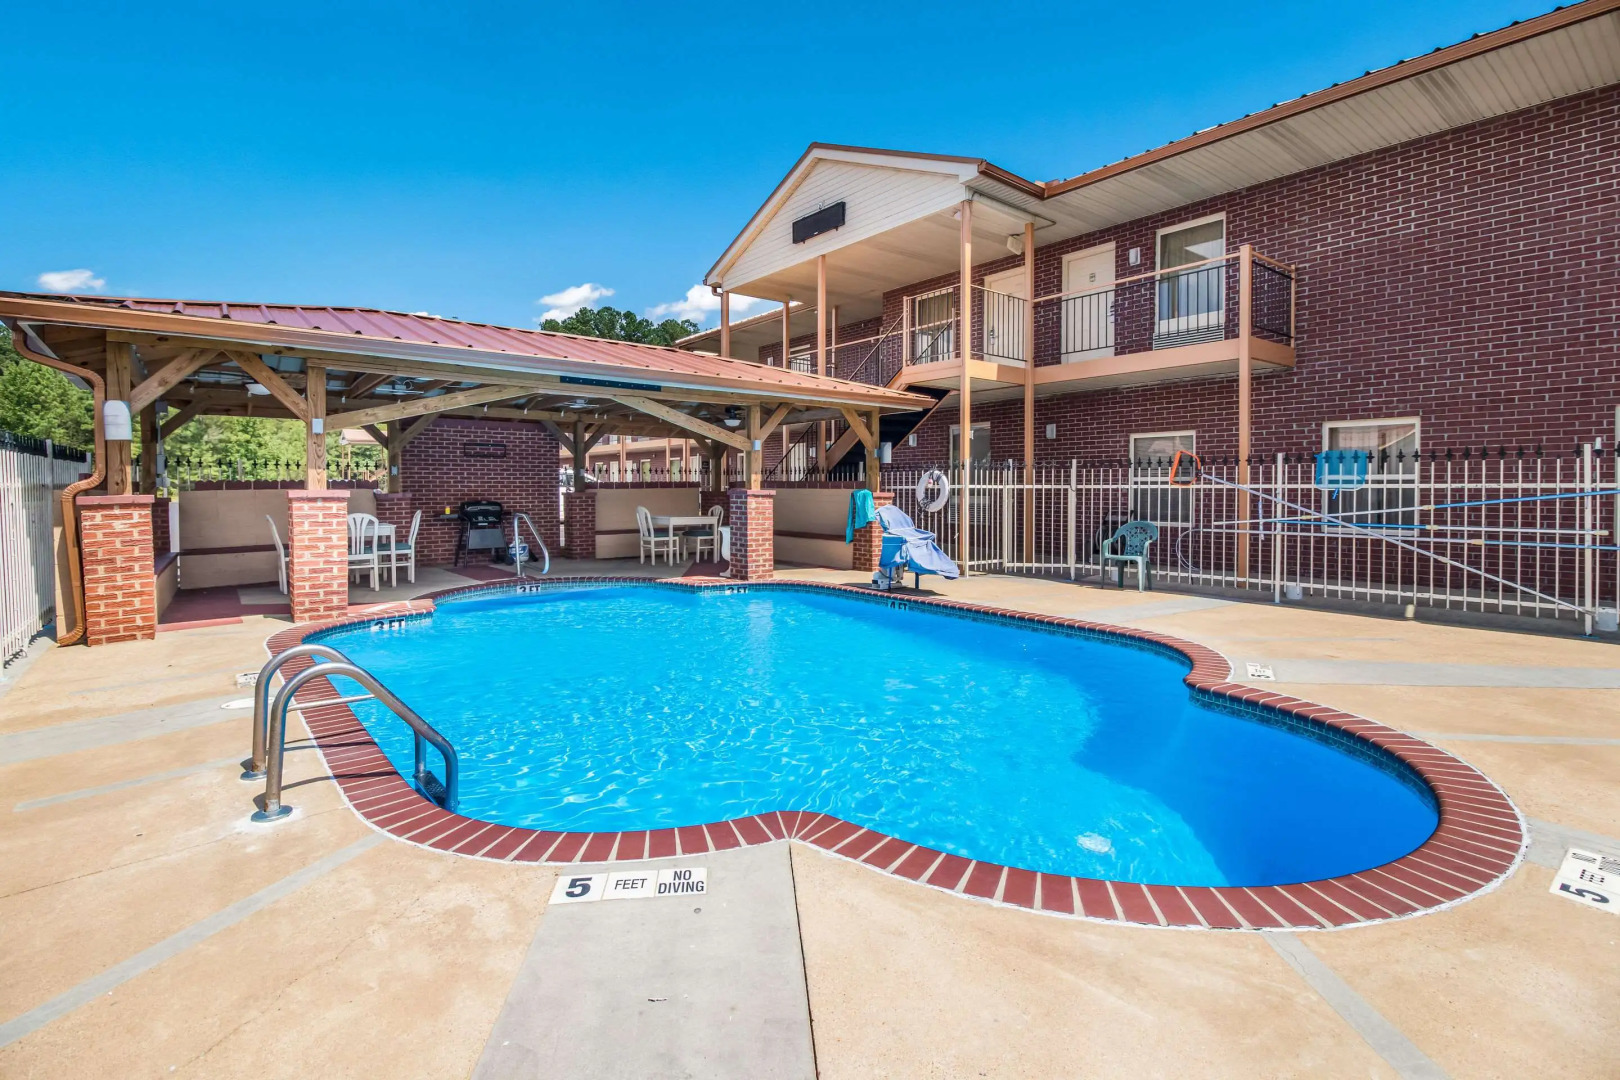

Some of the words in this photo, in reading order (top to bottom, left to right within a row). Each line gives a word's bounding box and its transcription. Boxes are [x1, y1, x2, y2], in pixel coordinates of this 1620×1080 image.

[673, 869, 692, 881] NO
[565, 877, 593, 898] 5
[614, 878, 648, 890] FEET
[657, 881, 705, 894] DIVING
[1559, 882, 1610, 904] 5
